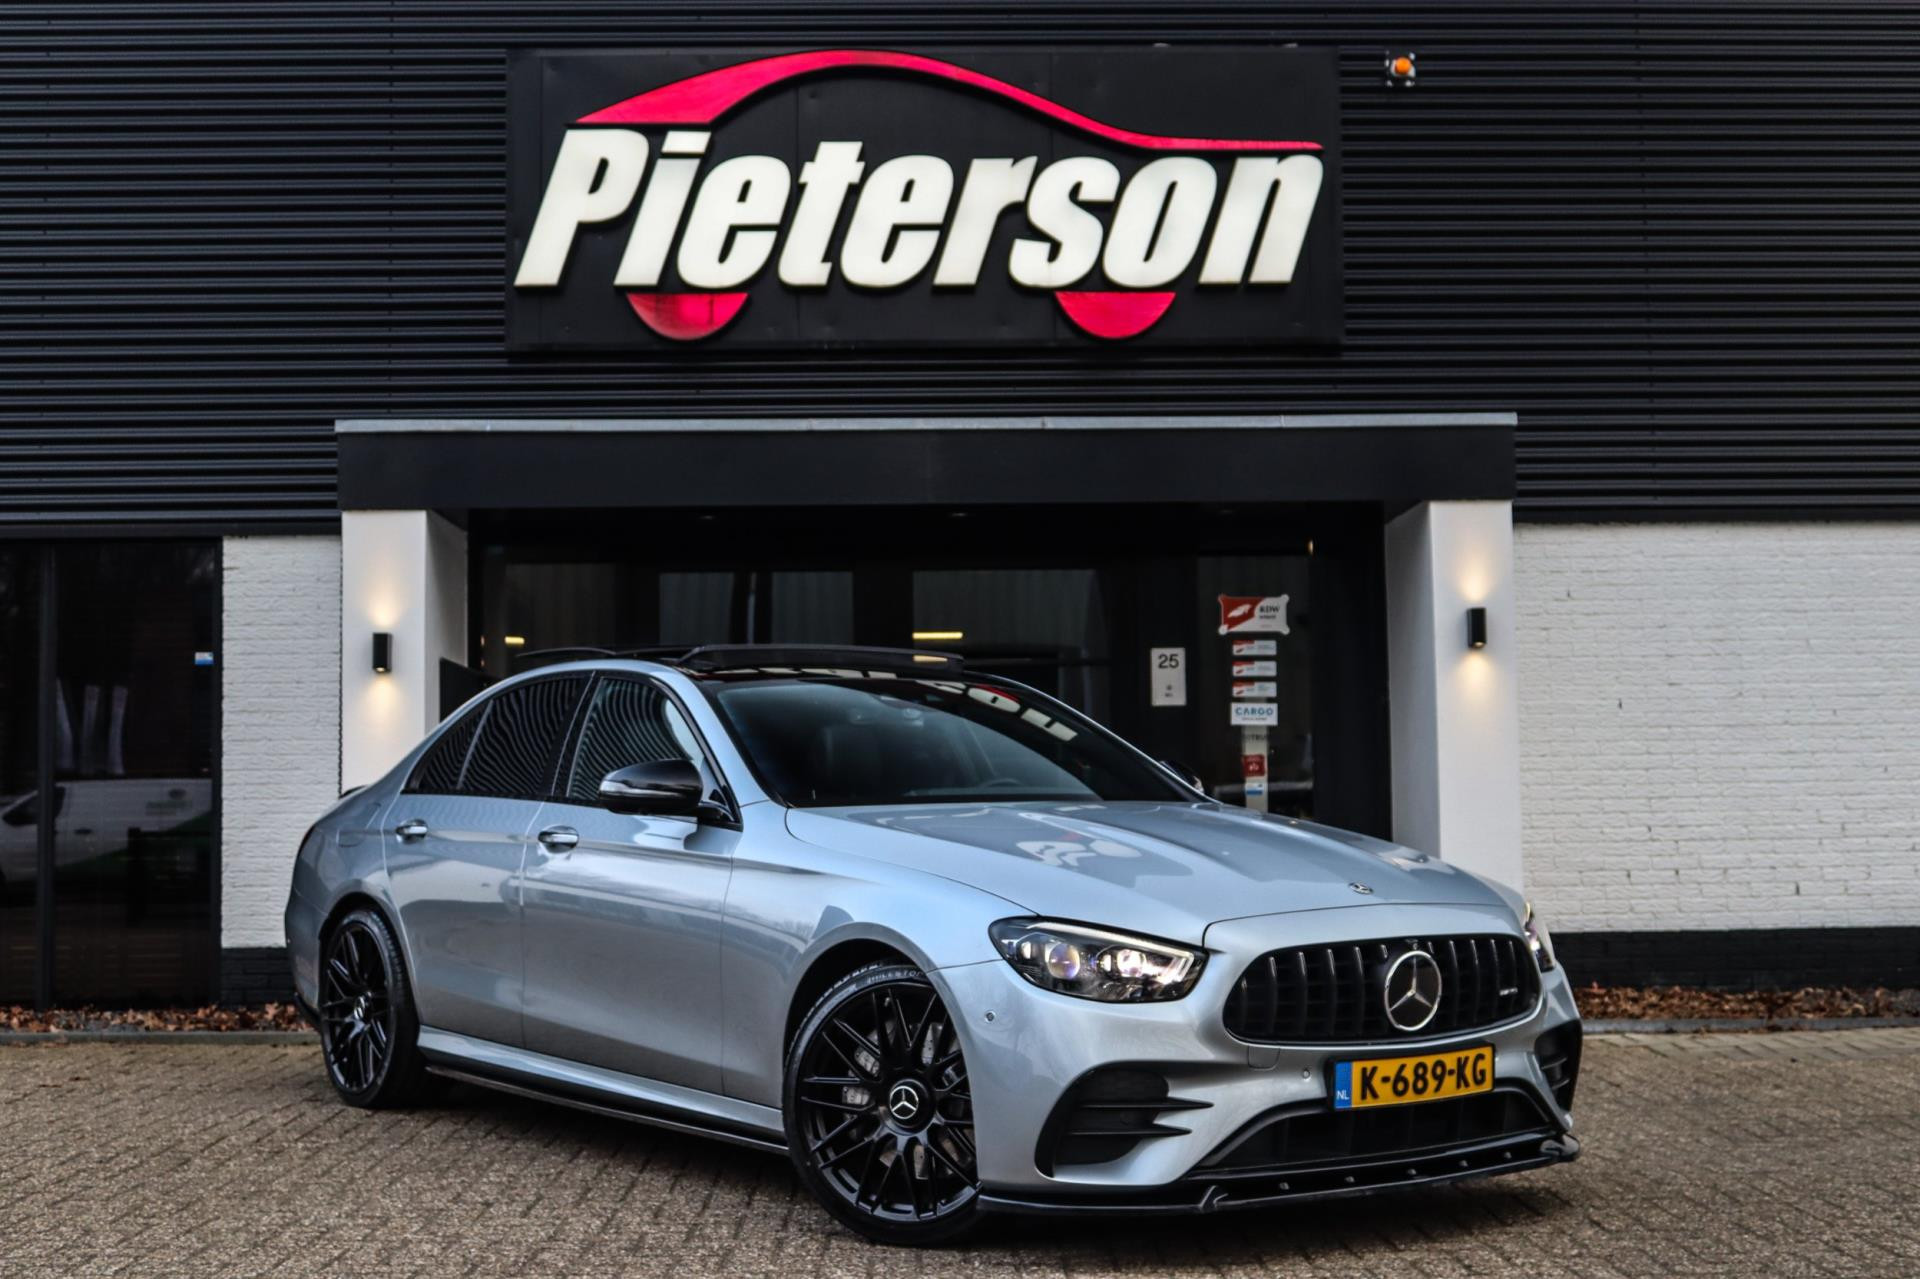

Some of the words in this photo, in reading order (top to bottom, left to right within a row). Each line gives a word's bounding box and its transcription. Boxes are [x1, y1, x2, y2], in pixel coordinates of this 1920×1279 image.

[514, 128, 1325, 289] Pieterson
[1158, 653, 1179, 669] 25
[1235, 706, 1274, 716] CARGO
[1361, 1053, 1487, 1101] K-689-KG
[1337, 1091, 1350, 1101] NL
